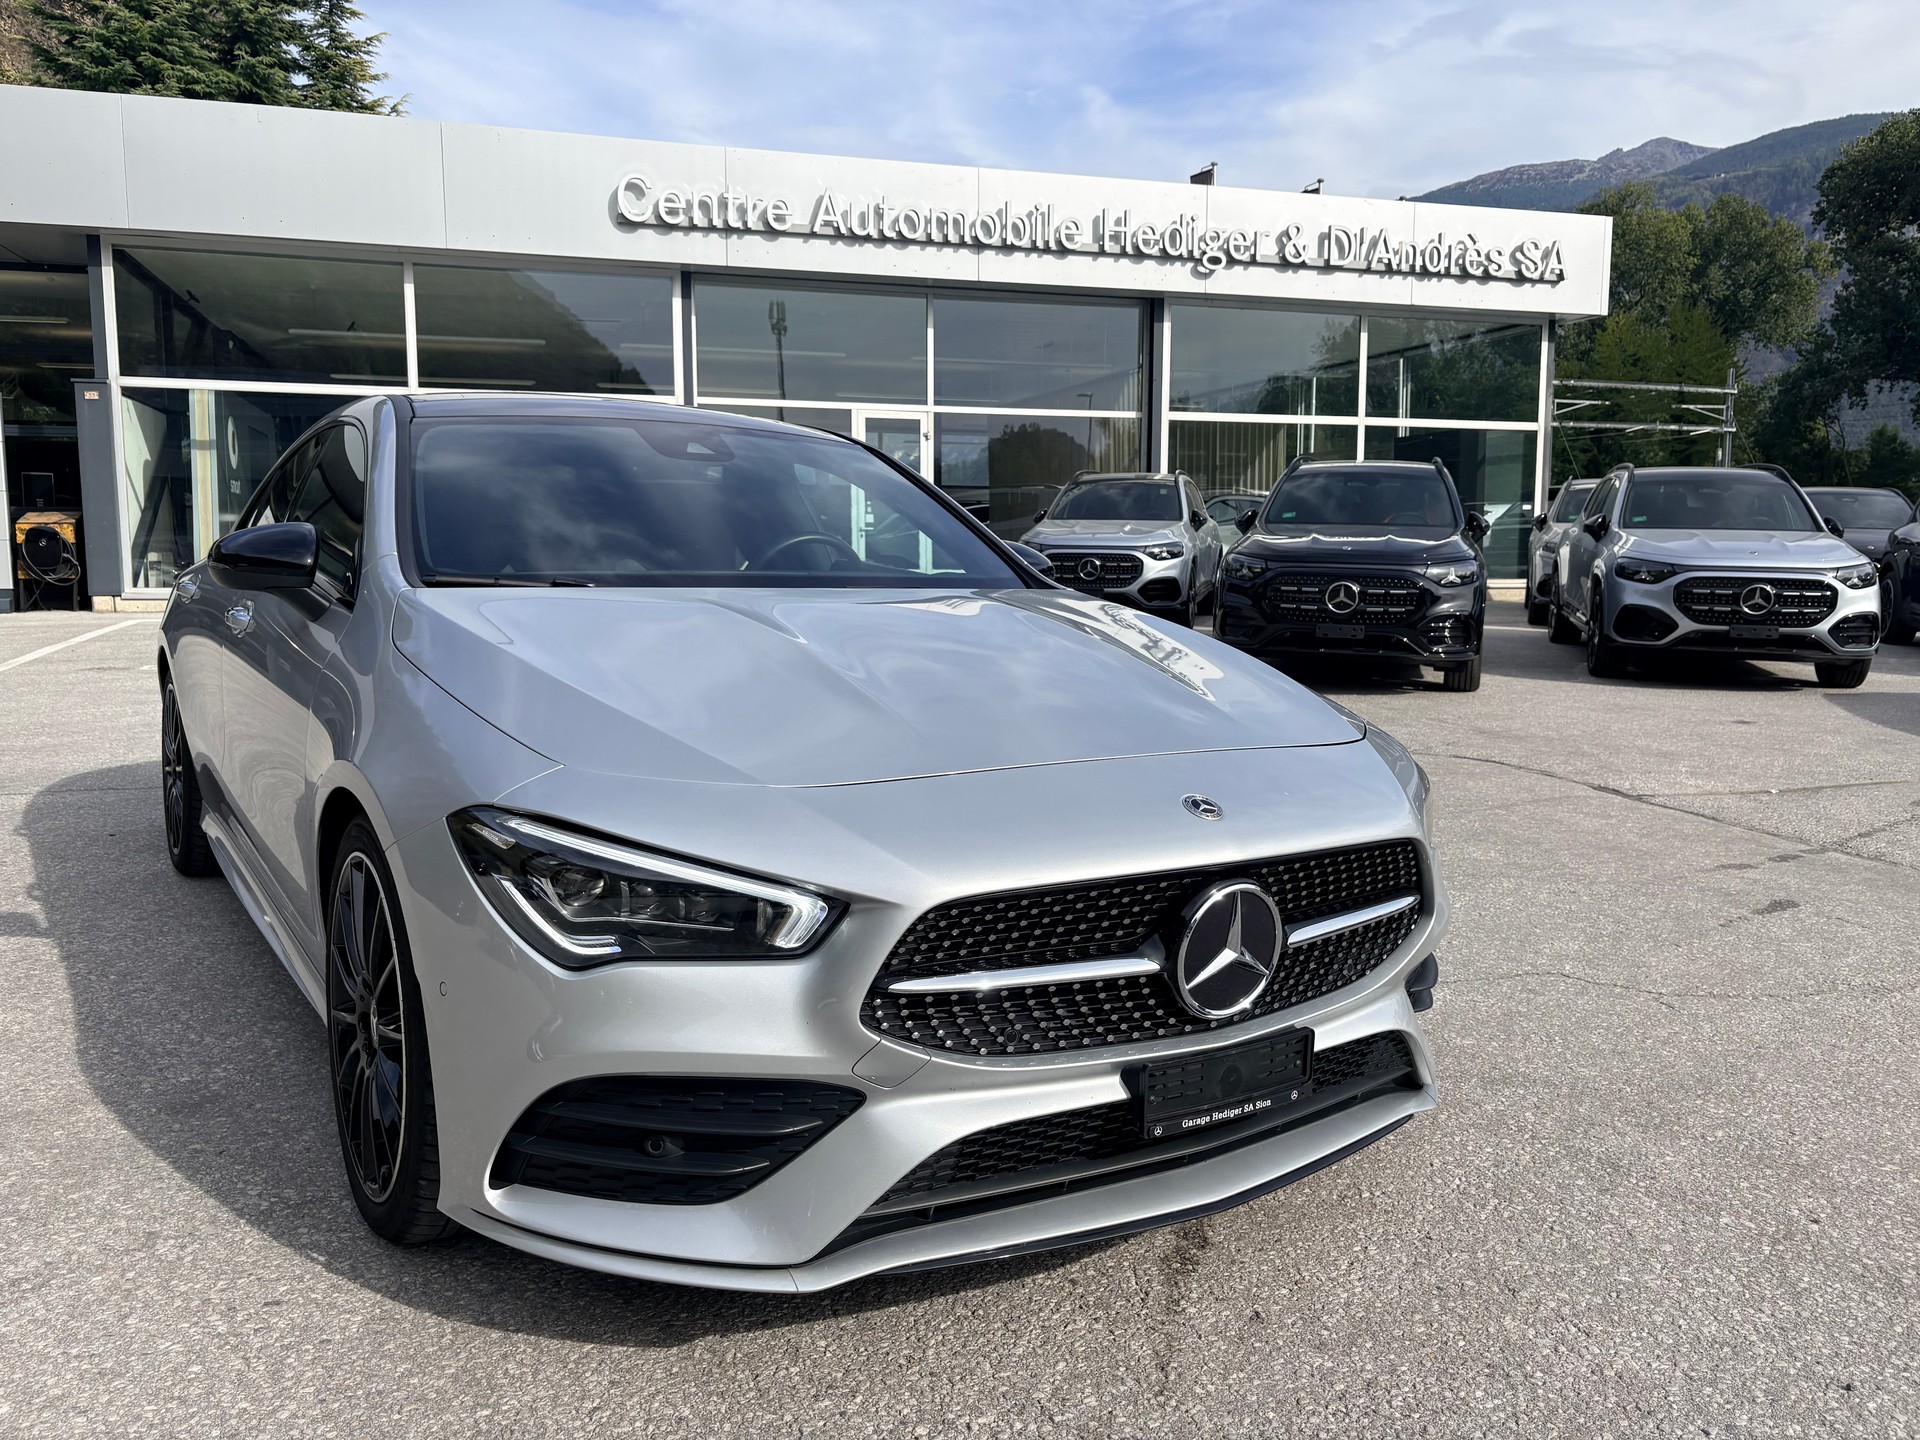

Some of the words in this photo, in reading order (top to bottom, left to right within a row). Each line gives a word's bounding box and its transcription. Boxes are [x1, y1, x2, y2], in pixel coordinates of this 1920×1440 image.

[617, 173, 793, 231] Centre
[812, 187, 1084, 250] Automobile
[1102, 207, 1271, 270] Hediger
[1284, 222, 1311, 264] &
[1328, 223, 1505, 276] D'Andrès
[1520, 237, 1568, 281] SA
[1182, 1115, 1211, 1128] Garage
[1212, 1106, 1243, 1121] Hediger
[1243, 1103, 1254, 1113] SA
[1255, 1098, 1271, 1110] Sion
